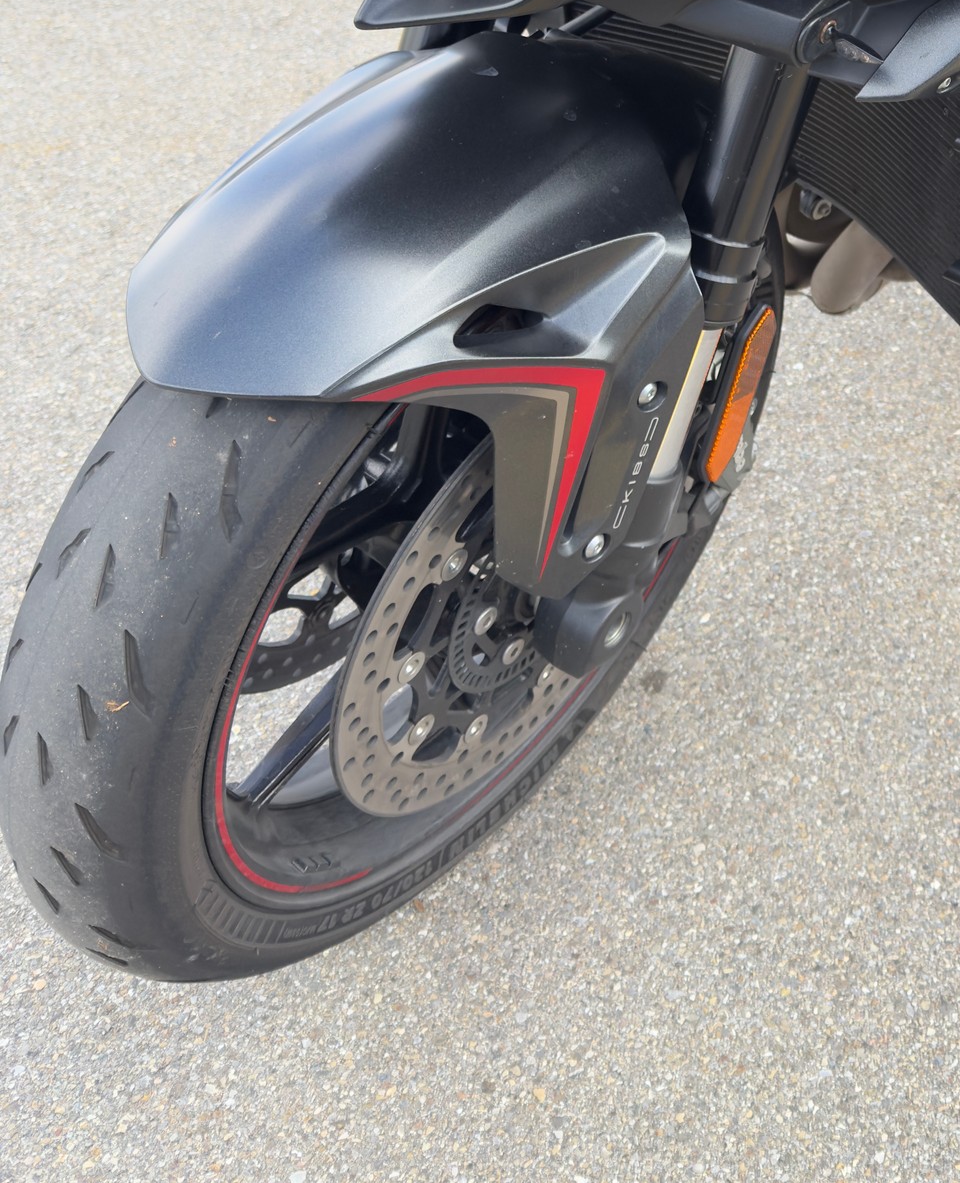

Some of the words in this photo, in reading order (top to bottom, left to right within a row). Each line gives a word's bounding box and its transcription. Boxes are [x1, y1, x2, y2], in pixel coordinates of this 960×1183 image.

[449, 743, 561, 860] MICHELIN
[370, 859, 433, 910] 120/70
[316, 913, 337, 933] 17
[341, 900, 367, 924] ZR
